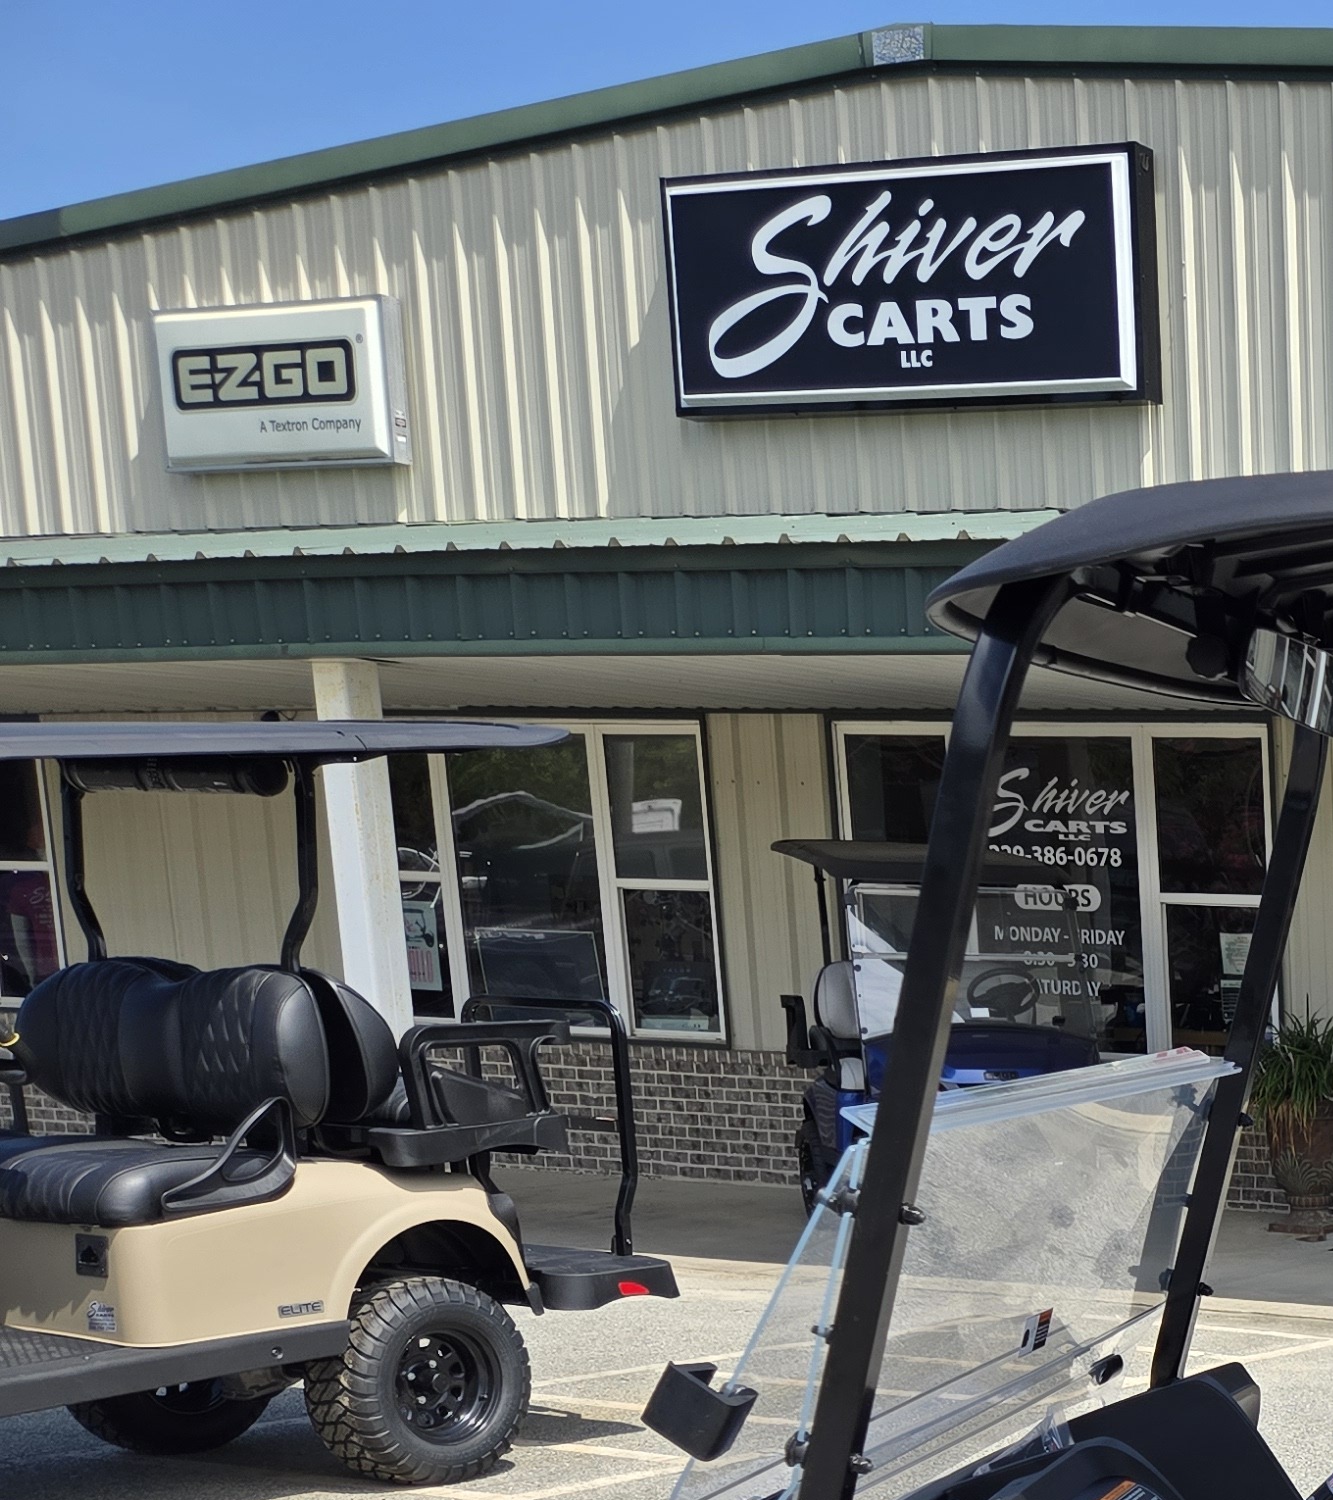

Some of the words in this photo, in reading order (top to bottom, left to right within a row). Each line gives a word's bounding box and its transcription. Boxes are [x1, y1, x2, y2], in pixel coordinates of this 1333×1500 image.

[709, 191, 1086, 378] Shiver
[827, 294, 1034, 348] CARTS
[900, 350, 934, 368] LLC
[177, 347, 349, 403] EZGO
[260, 421, 268, 433] A
[269, 420, 309, 433] Textron
[311, 418, 362, 433] Company
[988, 767, 1131, 838] Shiver
[1024, 819, 1128, 834] CARTS
[1078, 929, 1126, 946] RIDAY
[280, 1301, 322, 1316] ELITE
